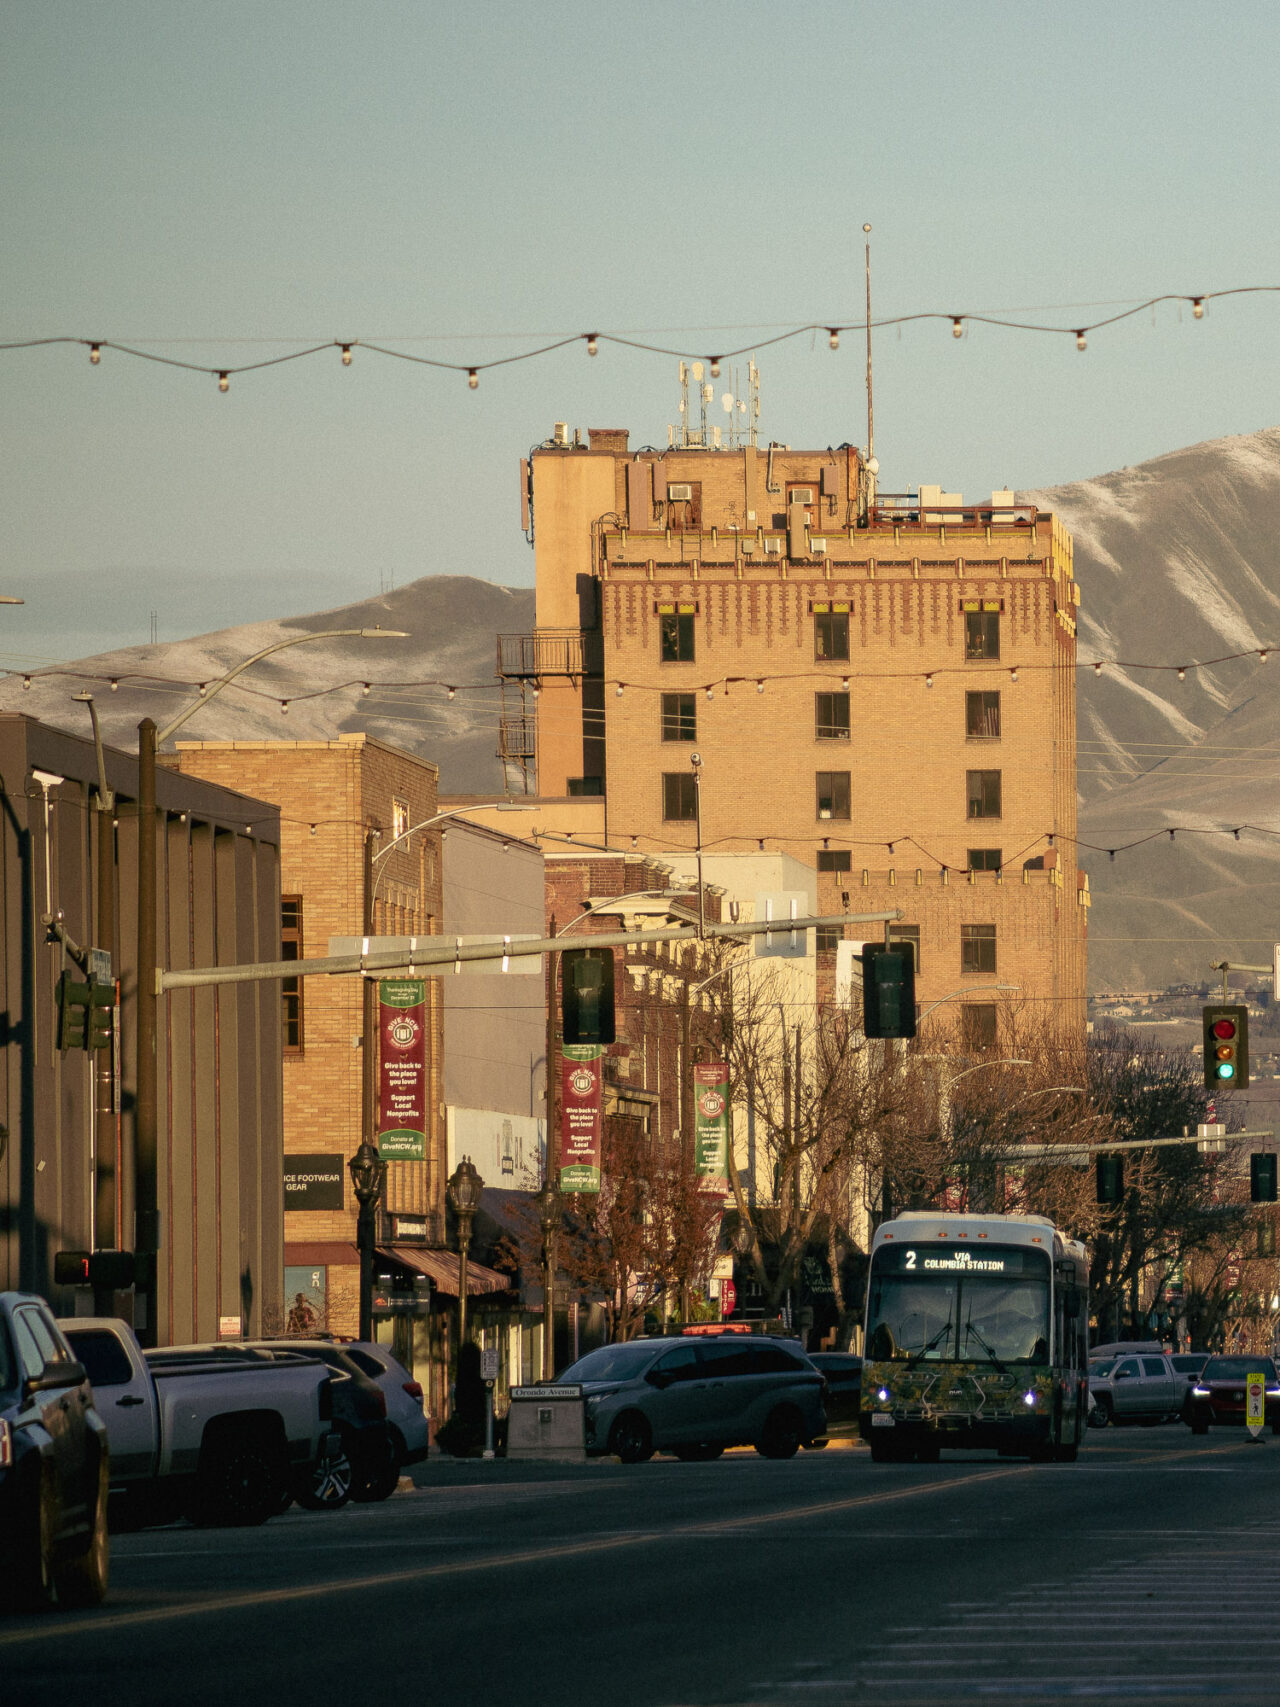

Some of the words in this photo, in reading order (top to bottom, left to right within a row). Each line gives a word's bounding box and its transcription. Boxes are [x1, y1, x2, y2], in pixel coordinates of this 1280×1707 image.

[387, 1017, 402, 1031] GIVE
[405, 1017, 419, 1031] NCW
[391, 1094, 415, 1102] Support
[386, 1110, 419, 1118] Nonprofits
[382, 1143, 422, 1151] GiveNCW.org
[905, 1251, 917, 1269] 2
[954, 1252, 971, 1261] VIA
[924, 1259, 966, 1269] COLUMBIA
[967, 1260, 1004, 1271] STATION
